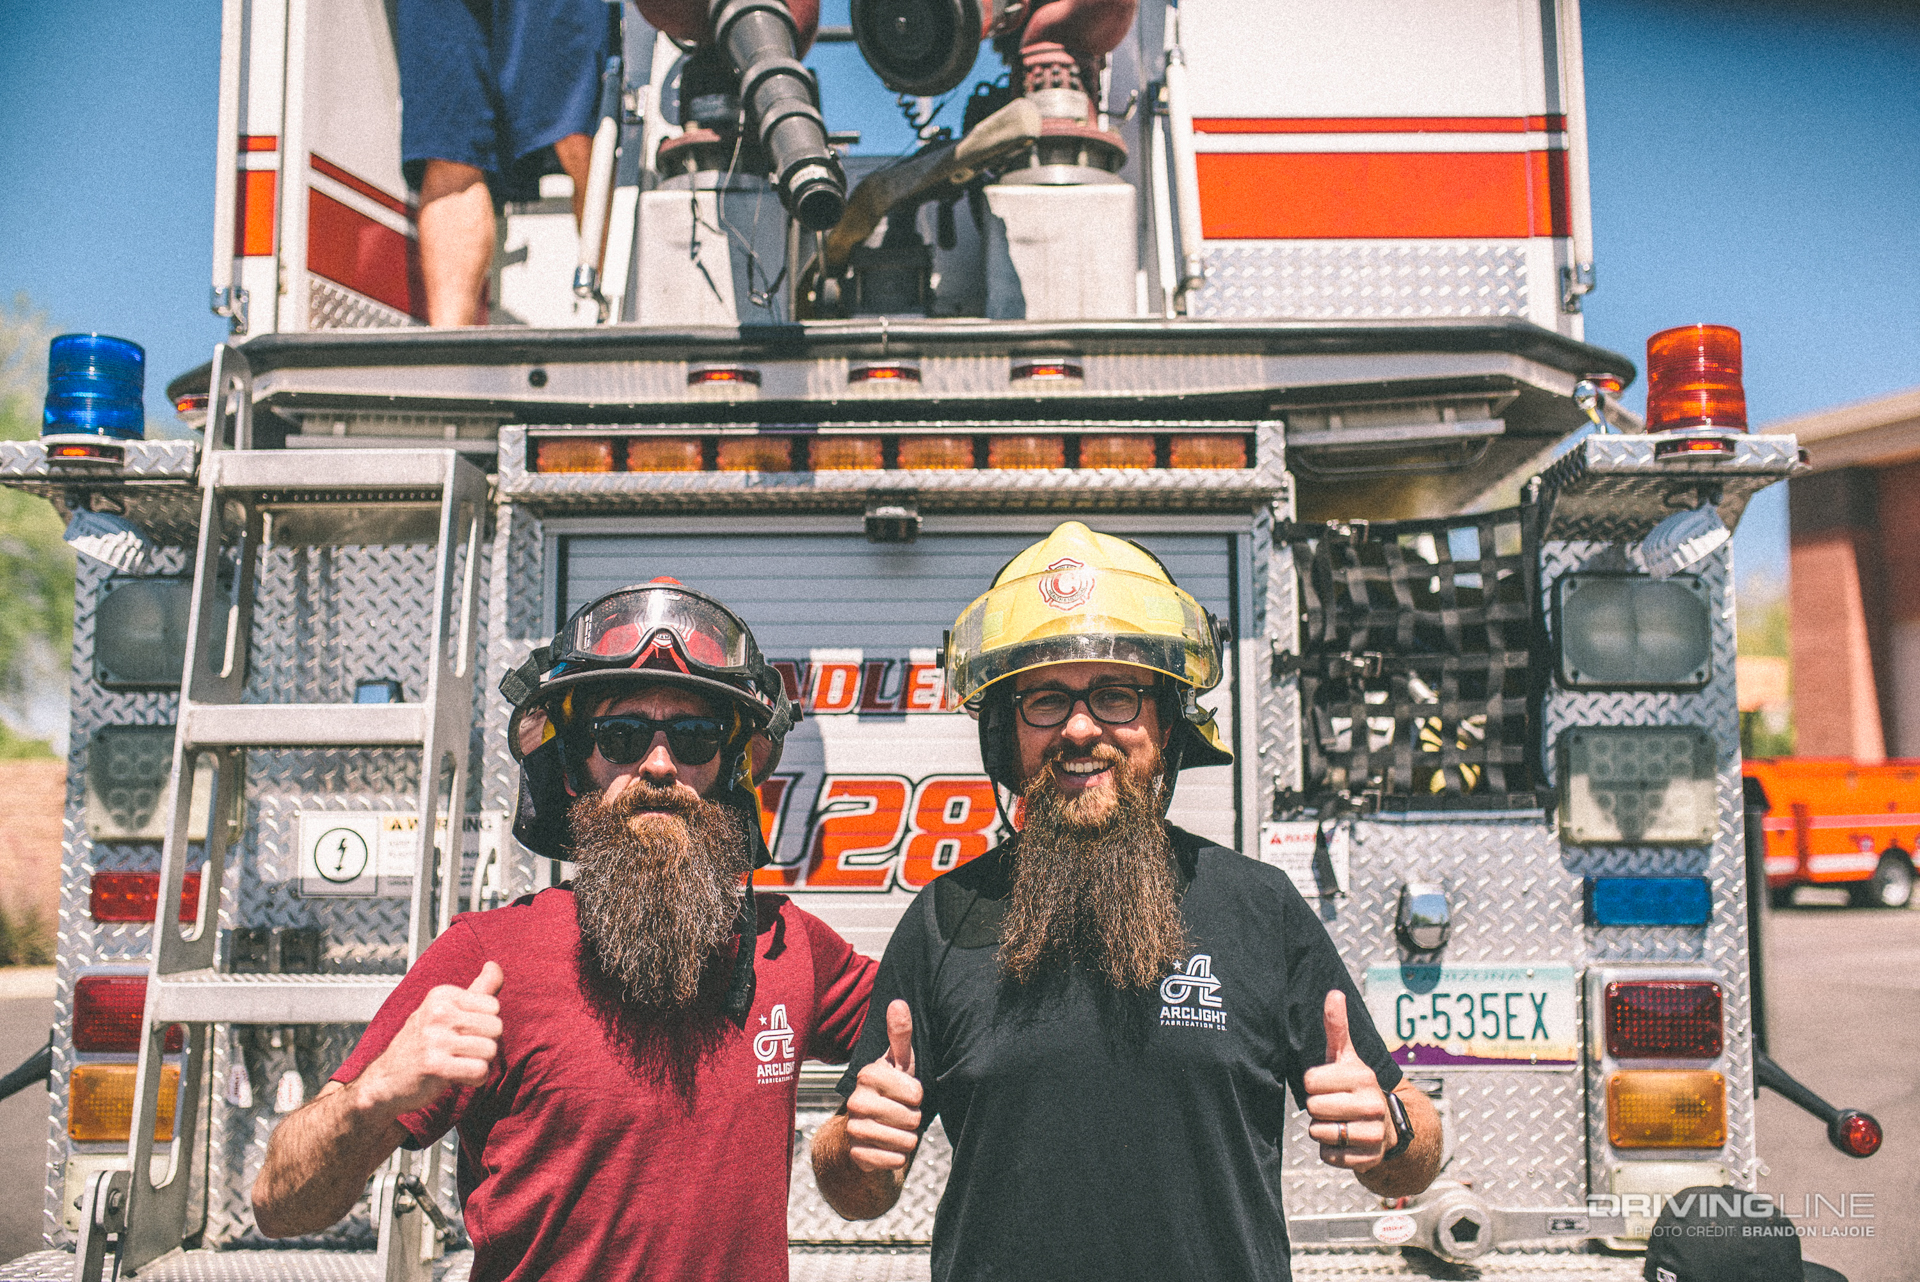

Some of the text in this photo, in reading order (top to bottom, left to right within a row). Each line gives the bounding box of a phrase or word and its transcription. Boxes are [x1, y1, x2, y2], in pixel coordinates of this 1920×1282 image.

[407, 818, 492, 832] WRING
[1160, 1006, 1228, 1025] ARCLIGHT
[1396, 992, 1549, 1040] G-535EX
[1160, 1020, 1214, 1030] FABRICATION
